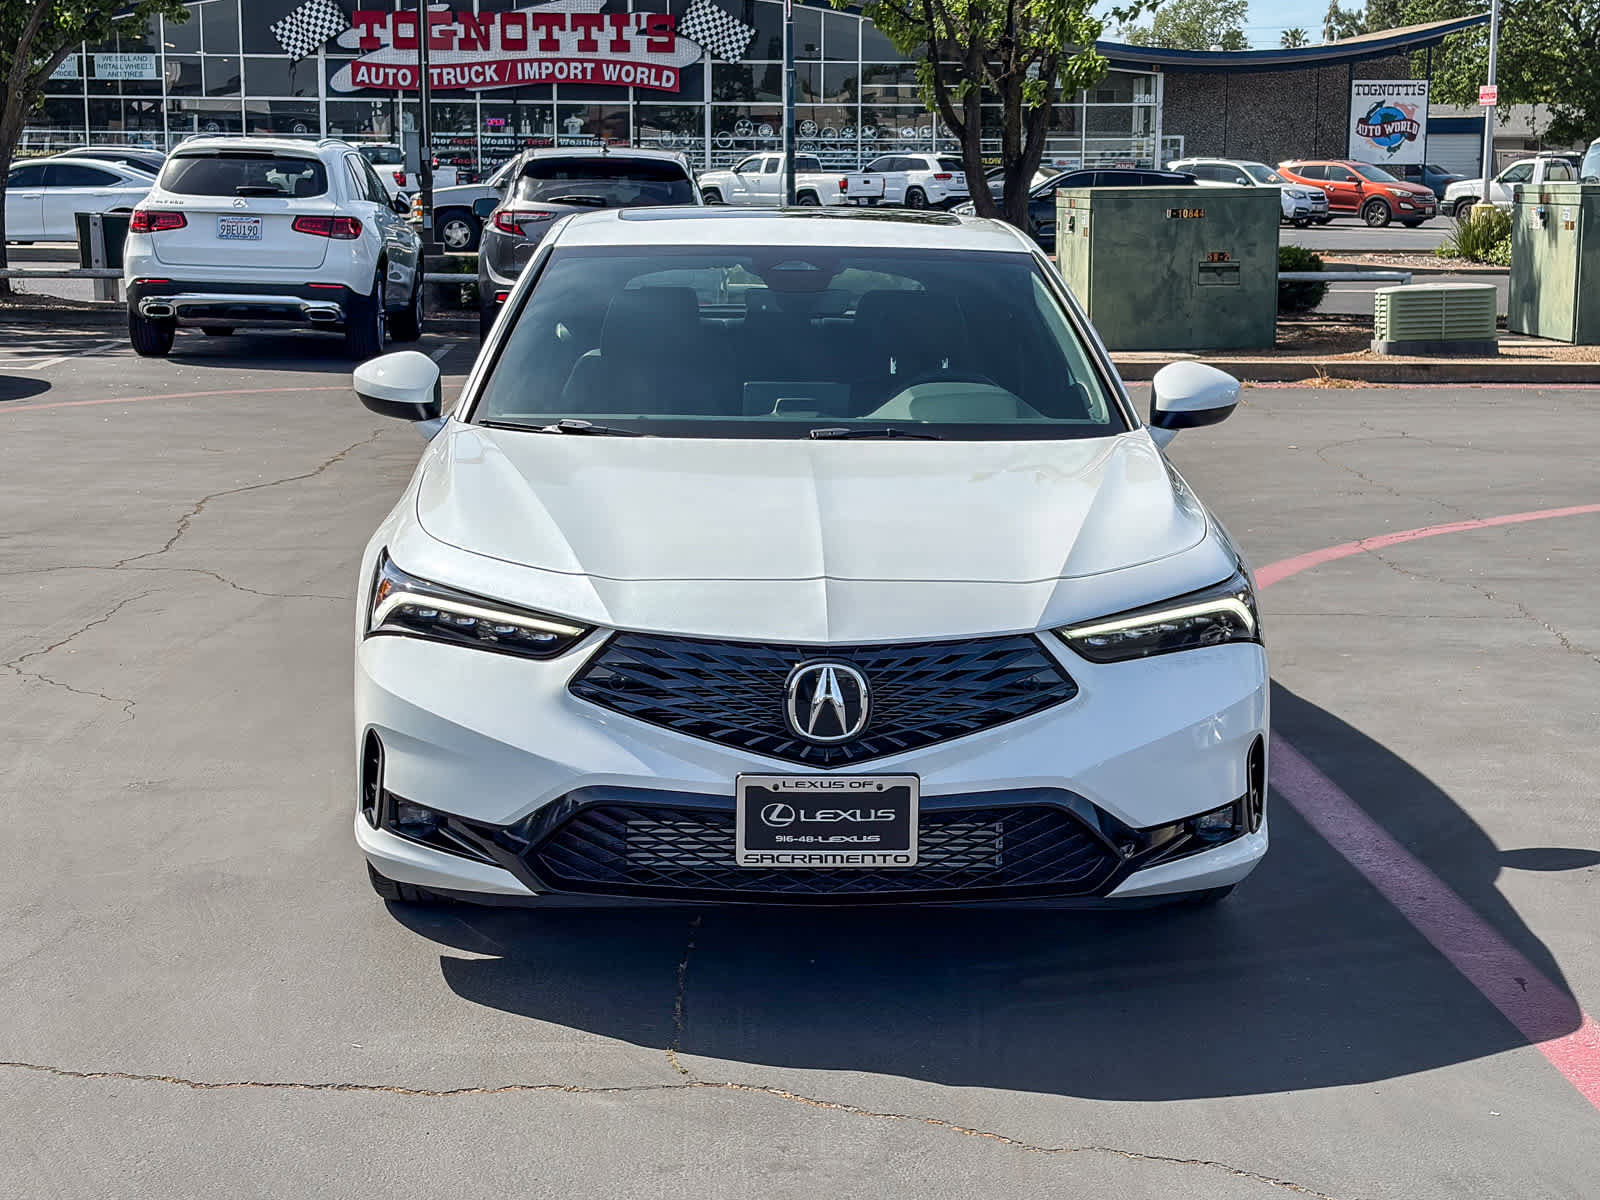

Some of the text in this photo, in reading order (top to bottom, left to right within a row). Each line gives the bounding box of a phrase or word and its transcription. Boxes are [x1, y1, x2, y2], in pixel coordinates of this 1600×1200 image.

[353, 10, 675, 53] TOGNOTTI'S
[356, 66, 412, 87] AUTO
[429, 64, 499, 86] TRUCK
[517, 62, 595, 80] IMPORT
[602, 63, 675, 88] WORLD
[1354, 82, 1426, 96] TOGNOTTI'S
[1357, 121, 1418, 136] AUTO WORLD
[782, 780, 874, 789] LEXUS OF
[800, 809, 896, 822] LEXUS
[743, 854, 911, 864] SACRAMENTO
